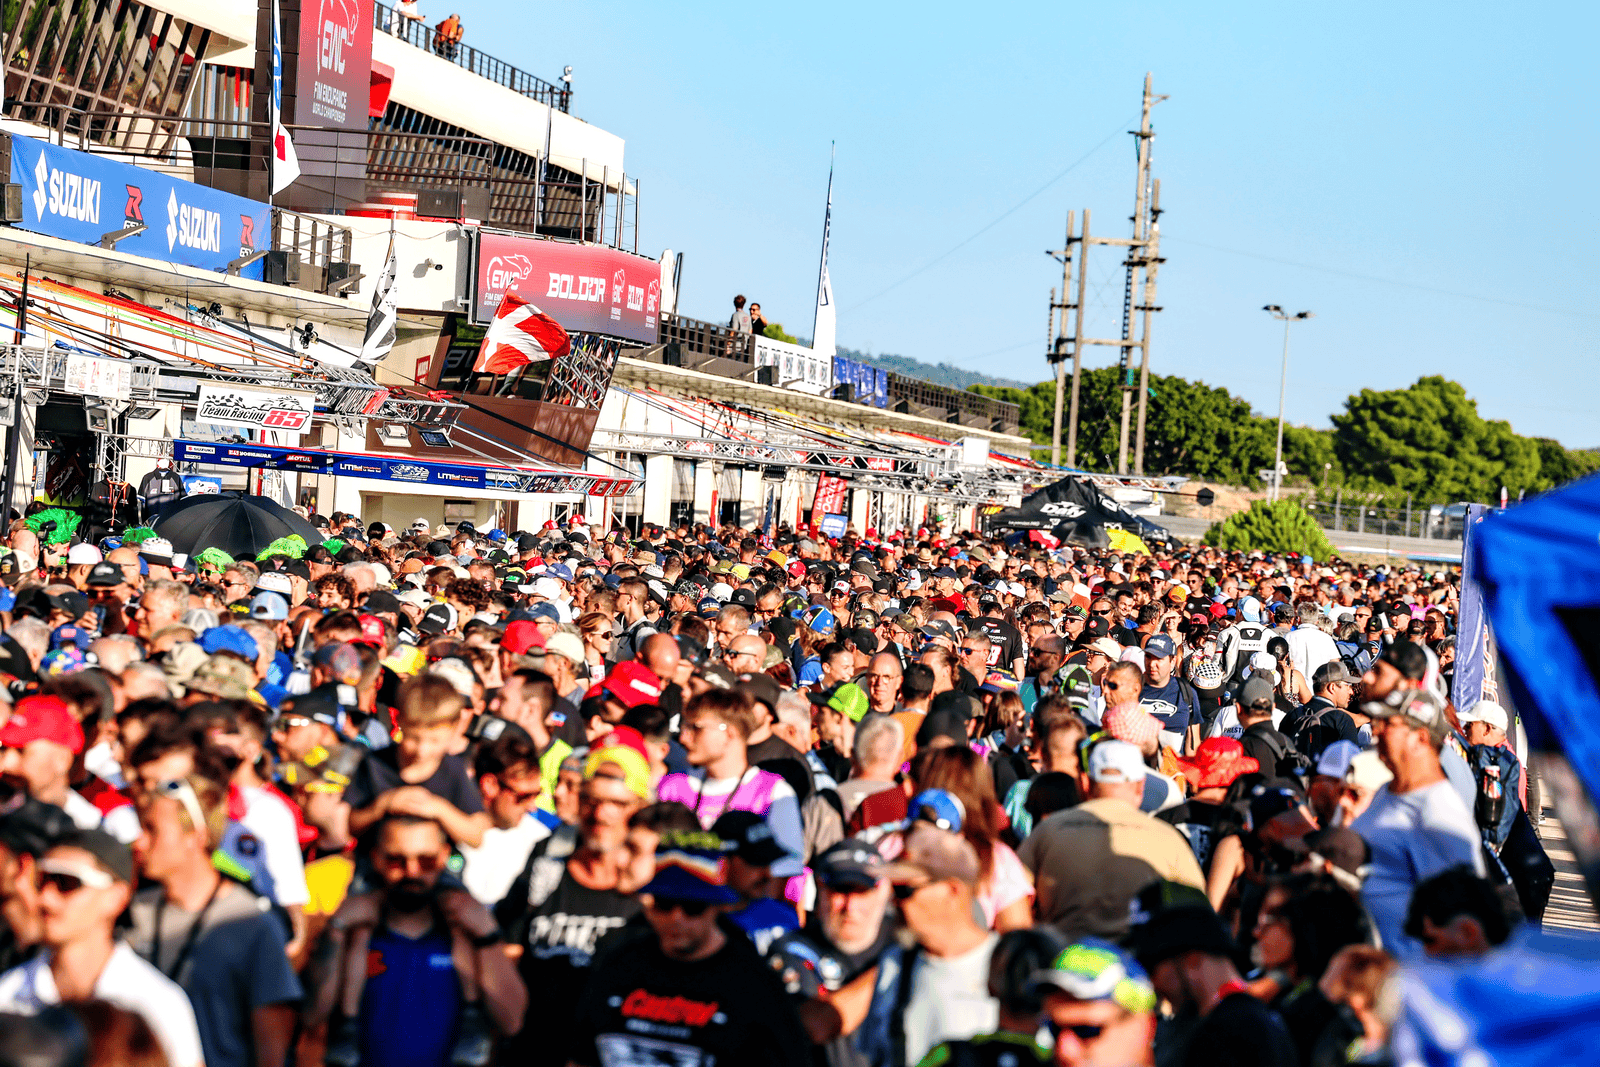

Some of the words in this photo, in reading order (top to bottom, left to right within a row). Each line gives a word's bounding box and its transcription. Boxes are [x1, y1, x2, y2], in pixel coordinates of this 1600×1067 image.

[48, 169, 101, 224] SUZUKI
[178, 202, 221, 253] SUZUKI
[491, 269, 520, 290] EWC
[203, 404, 230, 417] Team
[230, 407, 267, 422] Racing
[263, 410, 308, 428] 85
